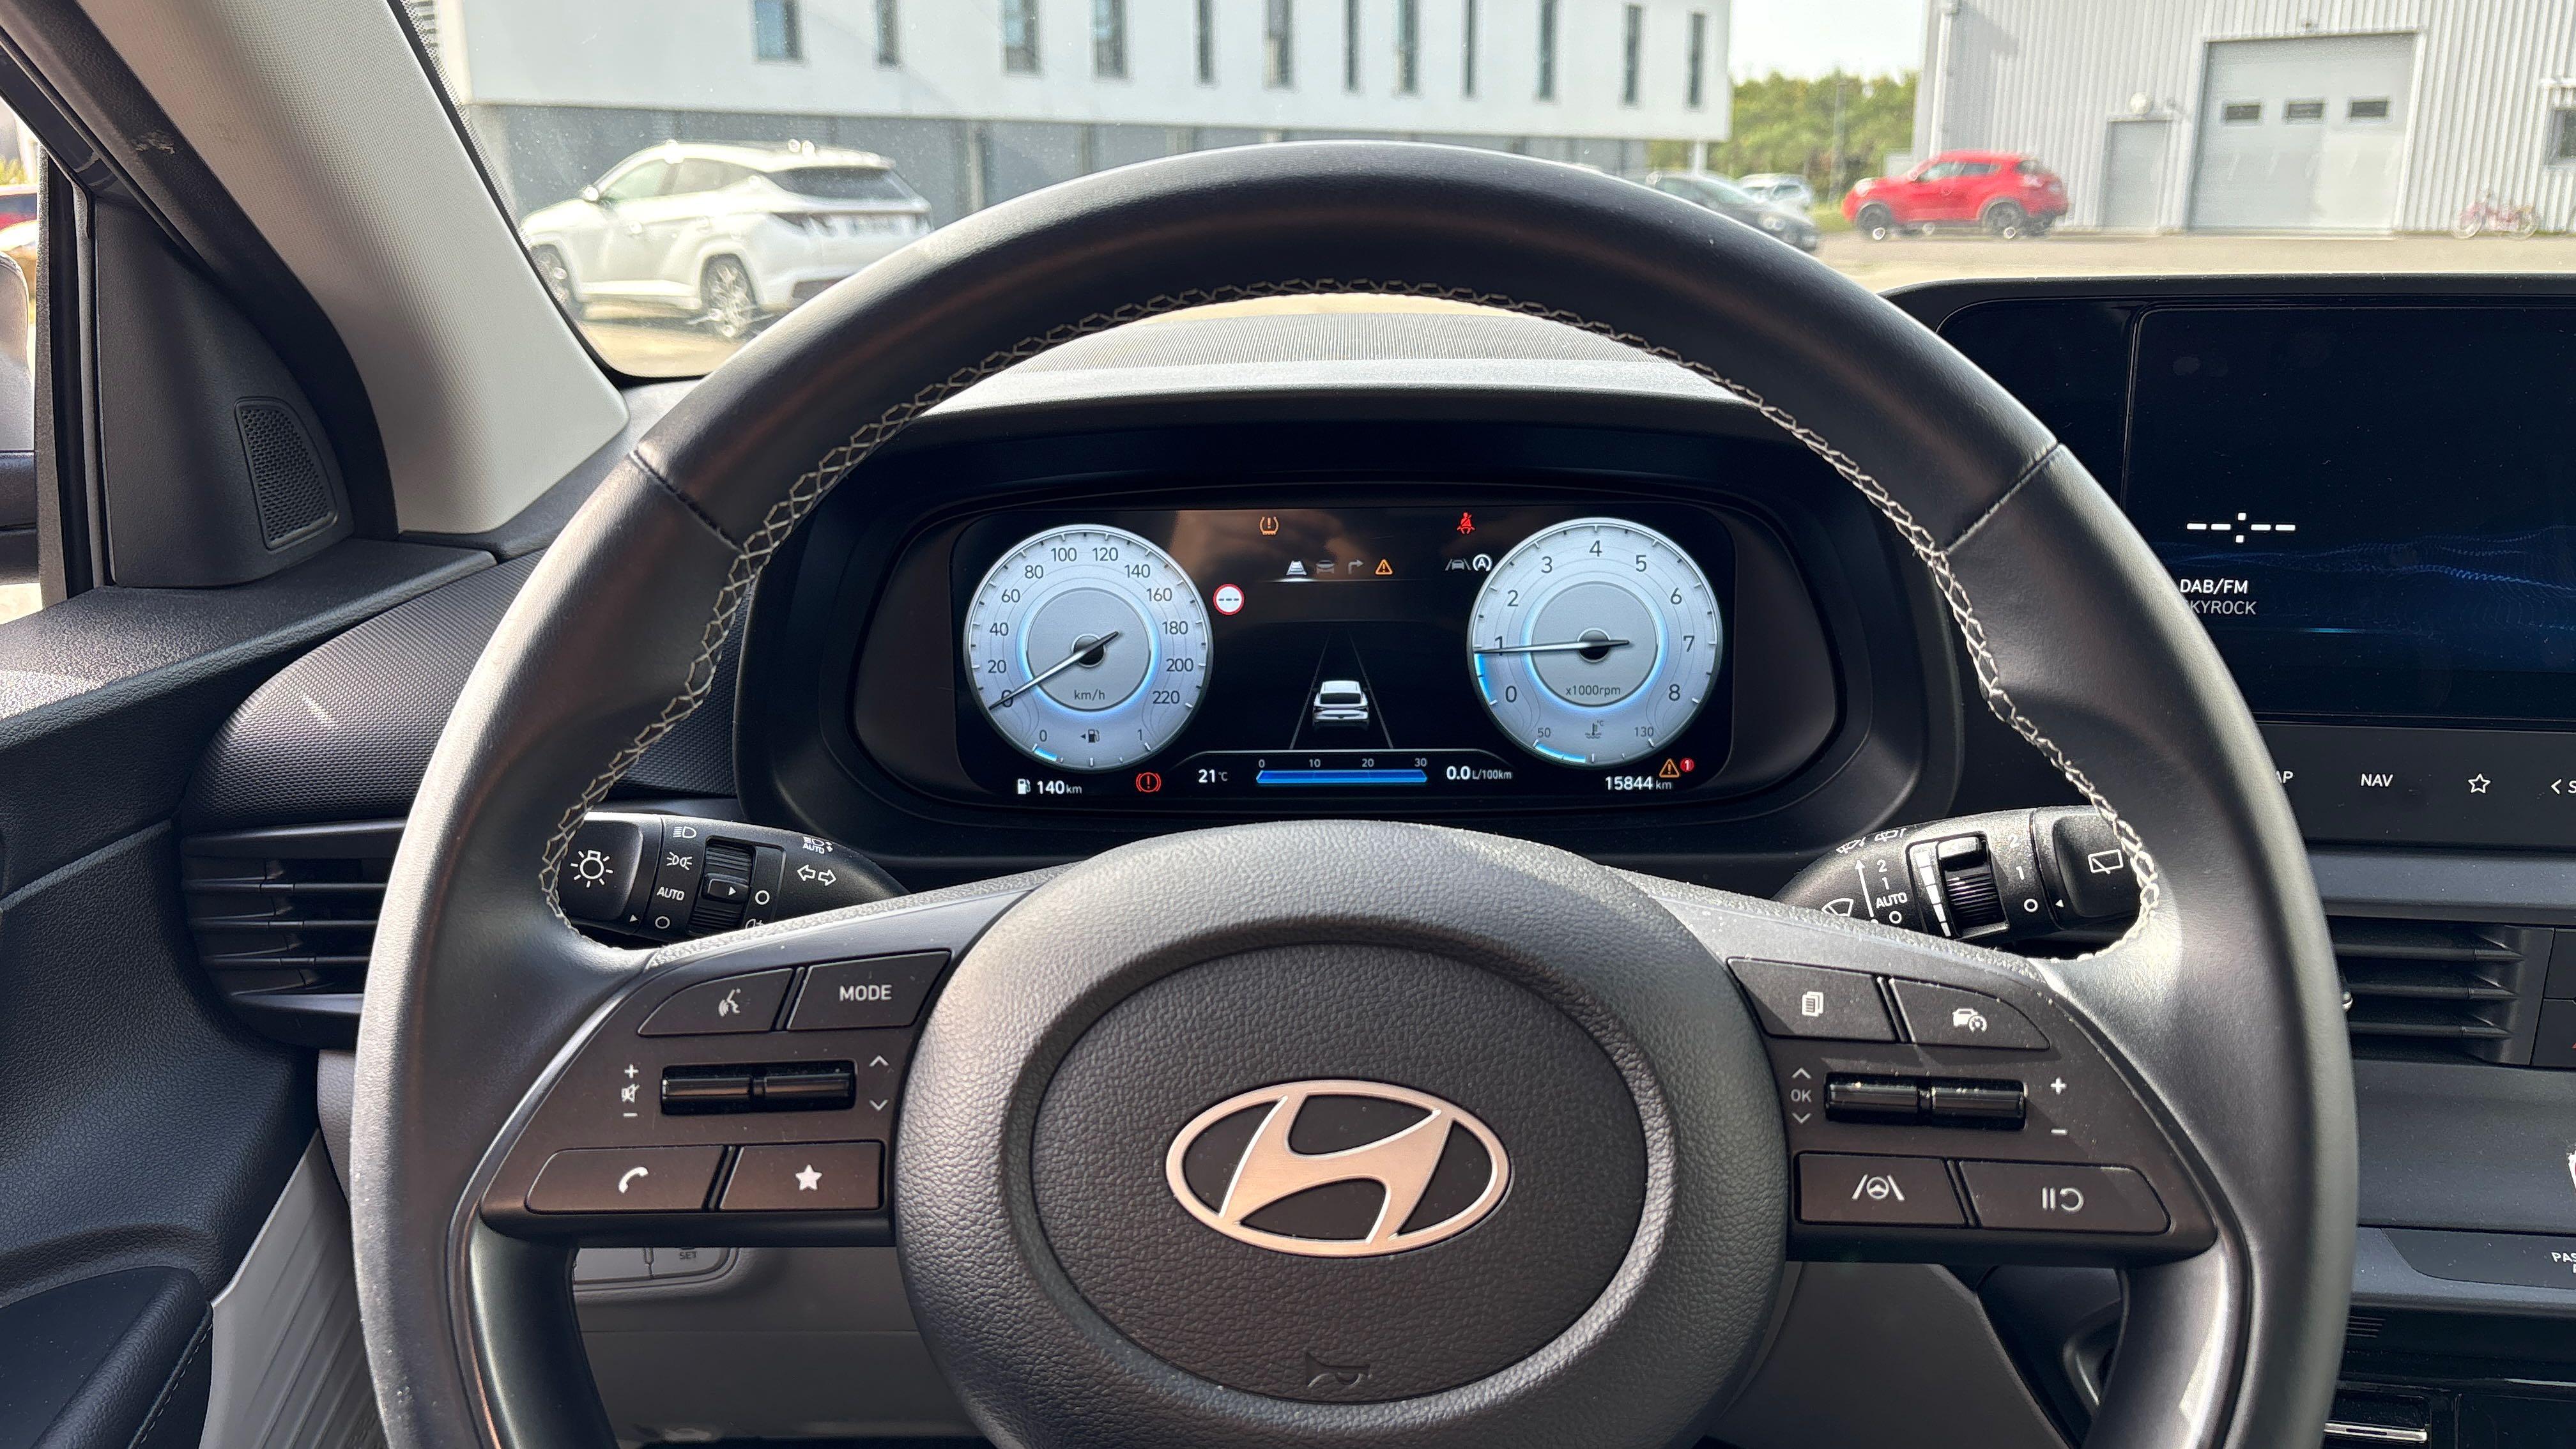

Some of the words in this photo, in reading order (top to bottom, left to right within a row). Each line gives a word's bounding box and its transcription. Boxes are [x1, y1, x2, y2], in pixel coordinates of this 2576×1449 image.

[1051, 548, 1077, 562] 100
[1093, 548, 1118, 562] 120
[1590, 540, 1602, 556] 4
[1541, 557, 1552, 573] 3
[1636, 555, 1646, 571] 5
[1025, 565, 1044, 579] 80
[1124, 564, 1151, 578] 140
[2180, 578, 2248, 595] DAB/FM
[1002, 589, 1020, 602] 60
[1147, 588, 1172, 602] 160
[1508, 590, 1519, 606] 2
[1671, 588, 1682, 604] 6
[2189, 600, 2257, 615] KYROCK
[990, 622, 1009, 636] 40
[1163, 621, 1188, 634] 180
[1683, 636, 1695, 652] 7
[988, 659, 1007, 673] 20
[1166, 658, 1193, 671] 200
[1075, 689, 1105, 702] km/h
[1153, 690, 1179, 704] 220
[1506, 686, 1517, 702] 0
[1669, 685, 1680, 701] 8
[1039, 730, 1047, 741] 0
[1137, 730, 1143, 740] 1
[1537, 727, 1551, 737] 50
[1634, 727, 1654, 737] 130
[1309, 758, 1321, 767] 10
[1362, 758, 1374, 767] 20
[1414, 758, 1427, 767] 30
[1199, 769, 1216, 783] 21
[1606, 776, 1653, 790] 15844
[2361, 773, 2393, 787] NAV
[802, 843, 825, 854] AUTO
[1877, 860, 1887, 873] 2
[657, 887, 684, 901] AUTO
[1876, 892, 1908, 908] AUTO
[839, 985, 892, 1001] MODE
[1791, 1089, 1811, 1102] OK
[679, 1251, 697, 1260] SET
